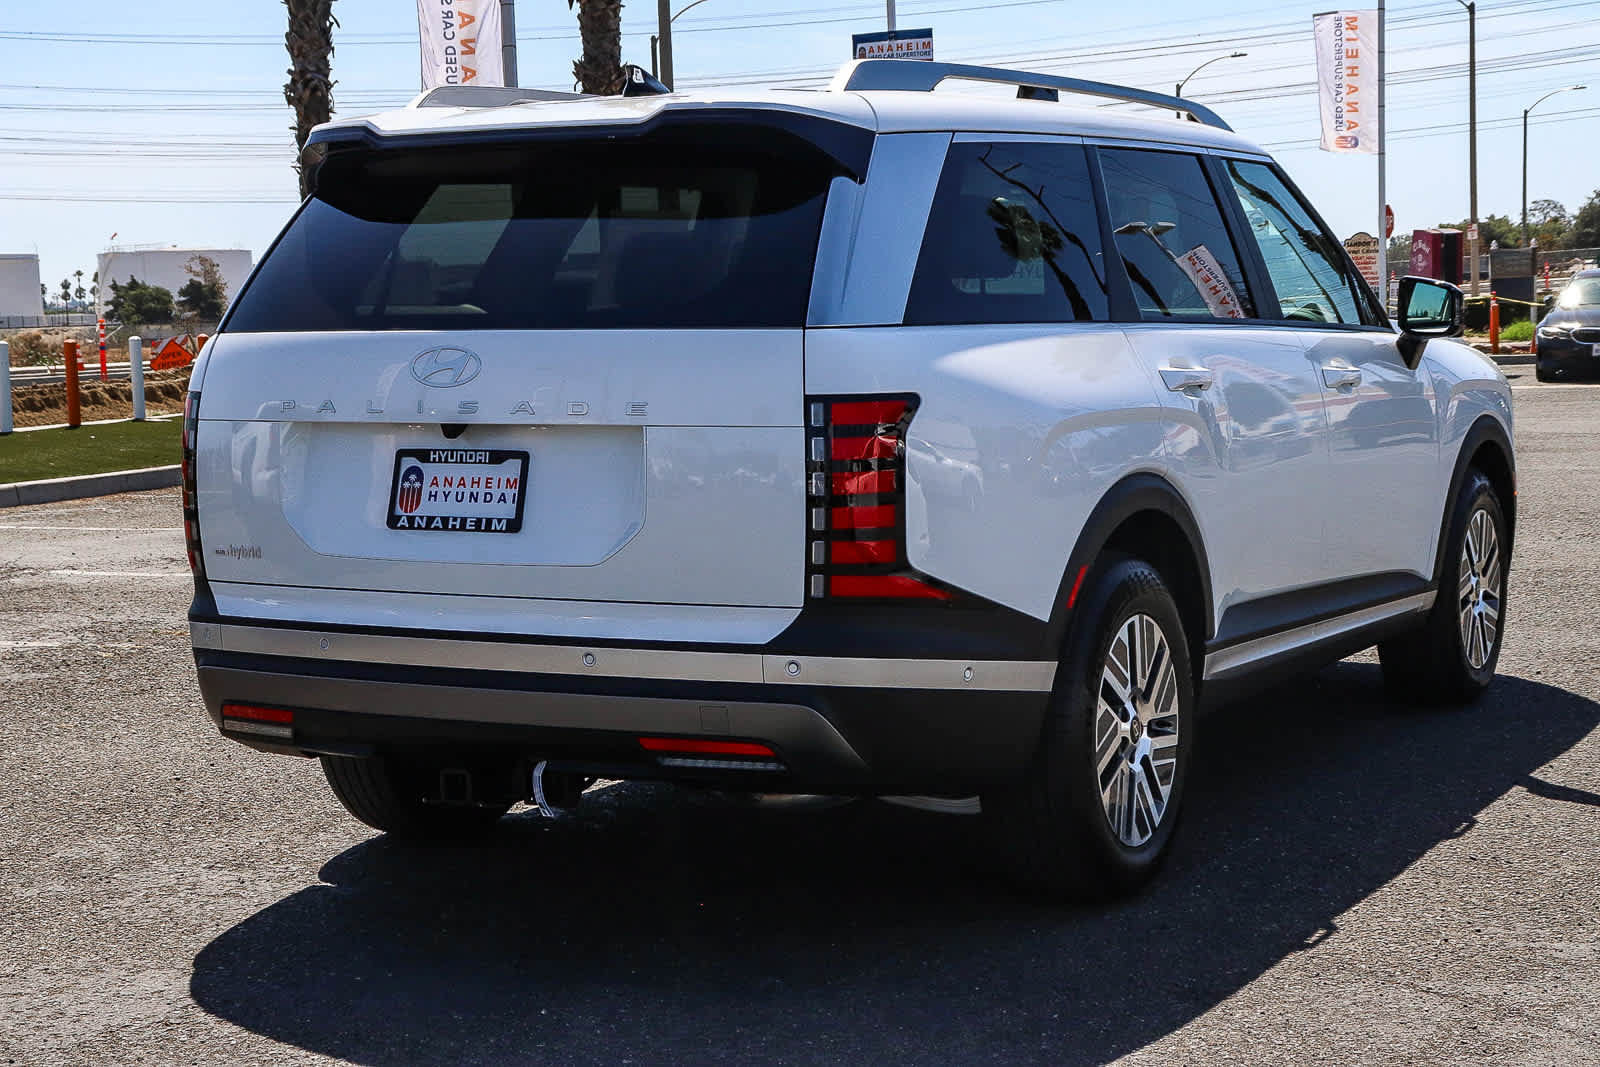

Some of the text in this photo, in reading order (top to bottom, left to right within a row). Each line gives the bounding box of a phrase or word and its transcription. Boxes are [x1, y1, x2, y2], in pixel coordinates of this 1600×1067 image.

[868, 41, 931, 54] ANAHEIM
[895, 50, 931, 58] SUPERSTORE
[279, 400, 649, 417] PALISADE
[429, 450, 490, 463] HYUNDAI
[429, 476, 519, 490] ANAHEIM
[427, 490, 516, 505] HYUNDAI
[397, 516, 508, 531] ANAHEIM
